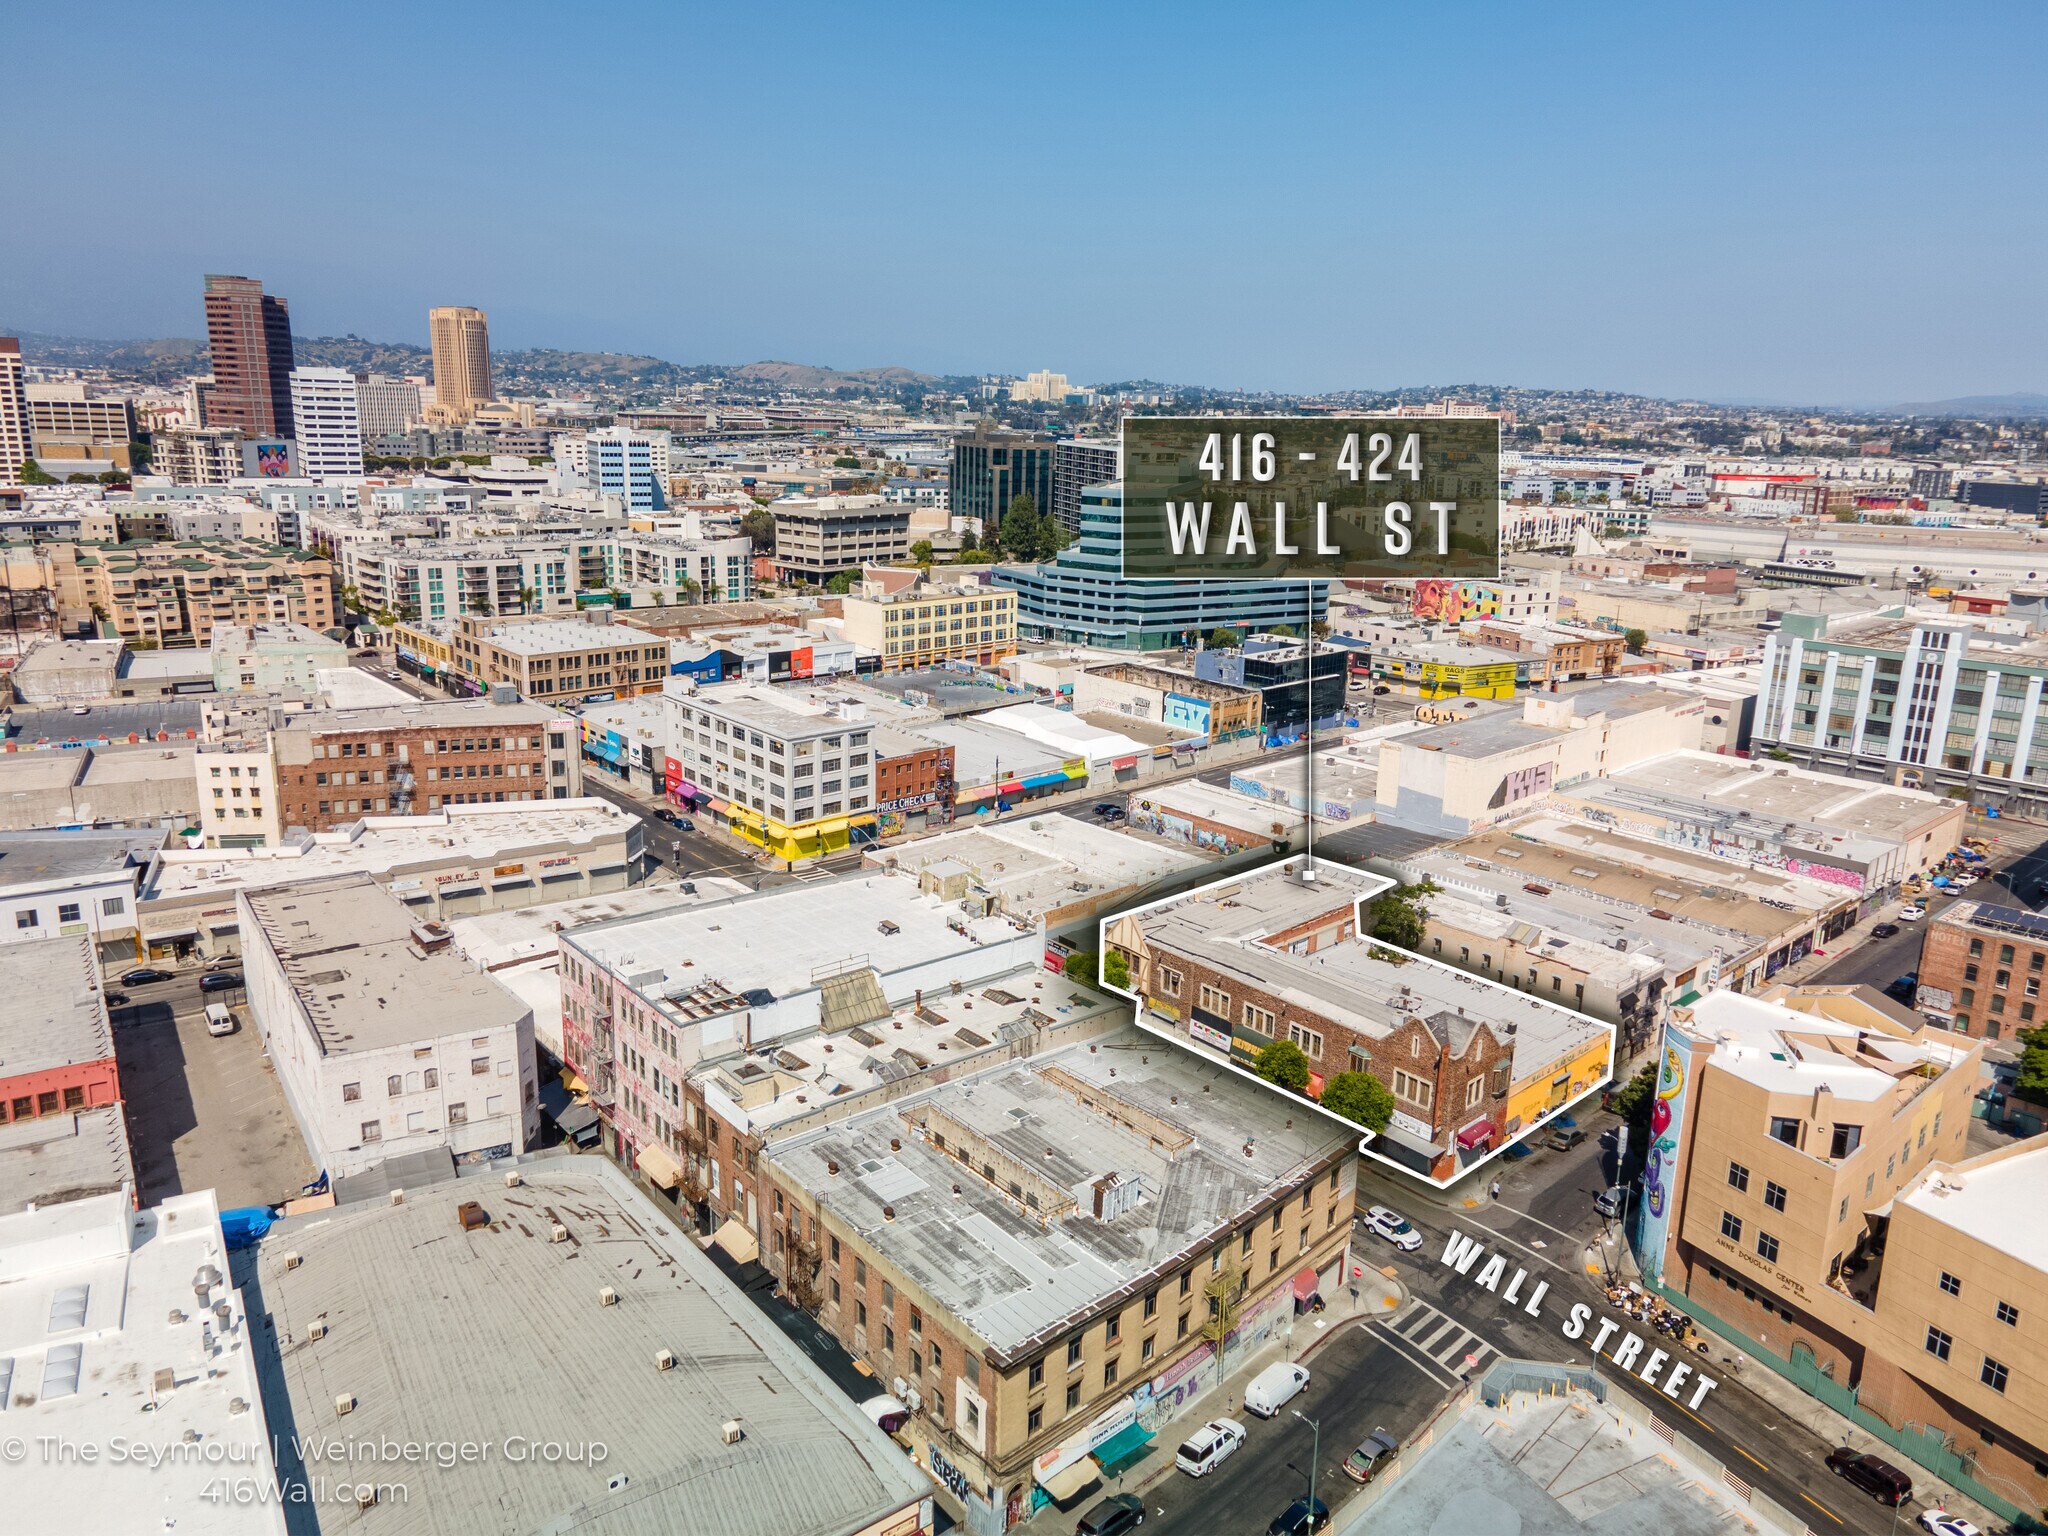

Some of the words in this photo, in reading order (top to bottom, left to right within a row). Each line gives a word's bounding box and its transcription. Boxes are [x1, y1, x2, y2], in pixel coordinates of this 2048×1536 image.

[1444, 666, 1465, 674] BAGS
[876, 799, 898, 813] PRICE
[898, 793, 926, 808] CHECK
[1930, 930, 1968, 947] HOTEL
[1715, 1237, 1735, 1253] ANNE
[1738, 1250, 1773, 1274] DOUGLAS
[1776, 1272, 1805, 1294] CENTER
[1091, 1428, 1109, 1443] PINK
[1110, 1411, 1135, 1431] HOUSE
